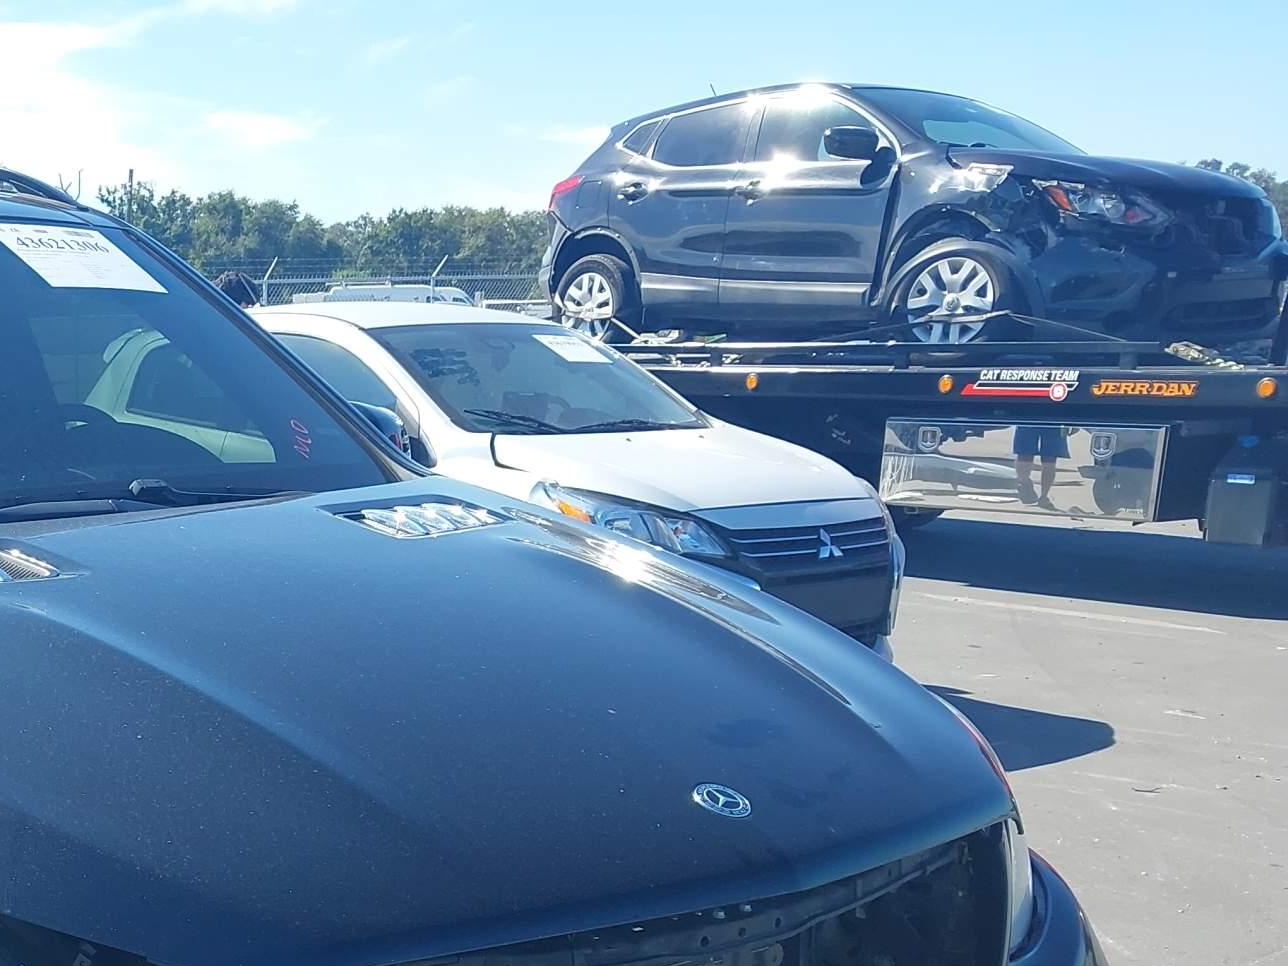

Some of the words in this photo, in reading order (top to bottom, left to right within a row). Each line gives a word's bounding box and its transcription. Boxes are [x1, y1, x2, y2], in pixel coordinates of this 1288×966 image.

[16, 236, 110, 253] 43621306
[980, 370, 1000, 380] CAT
[1000, 370, 1049, 380] RESPONSE
[1050, 371, 1080, 380] TEAM
